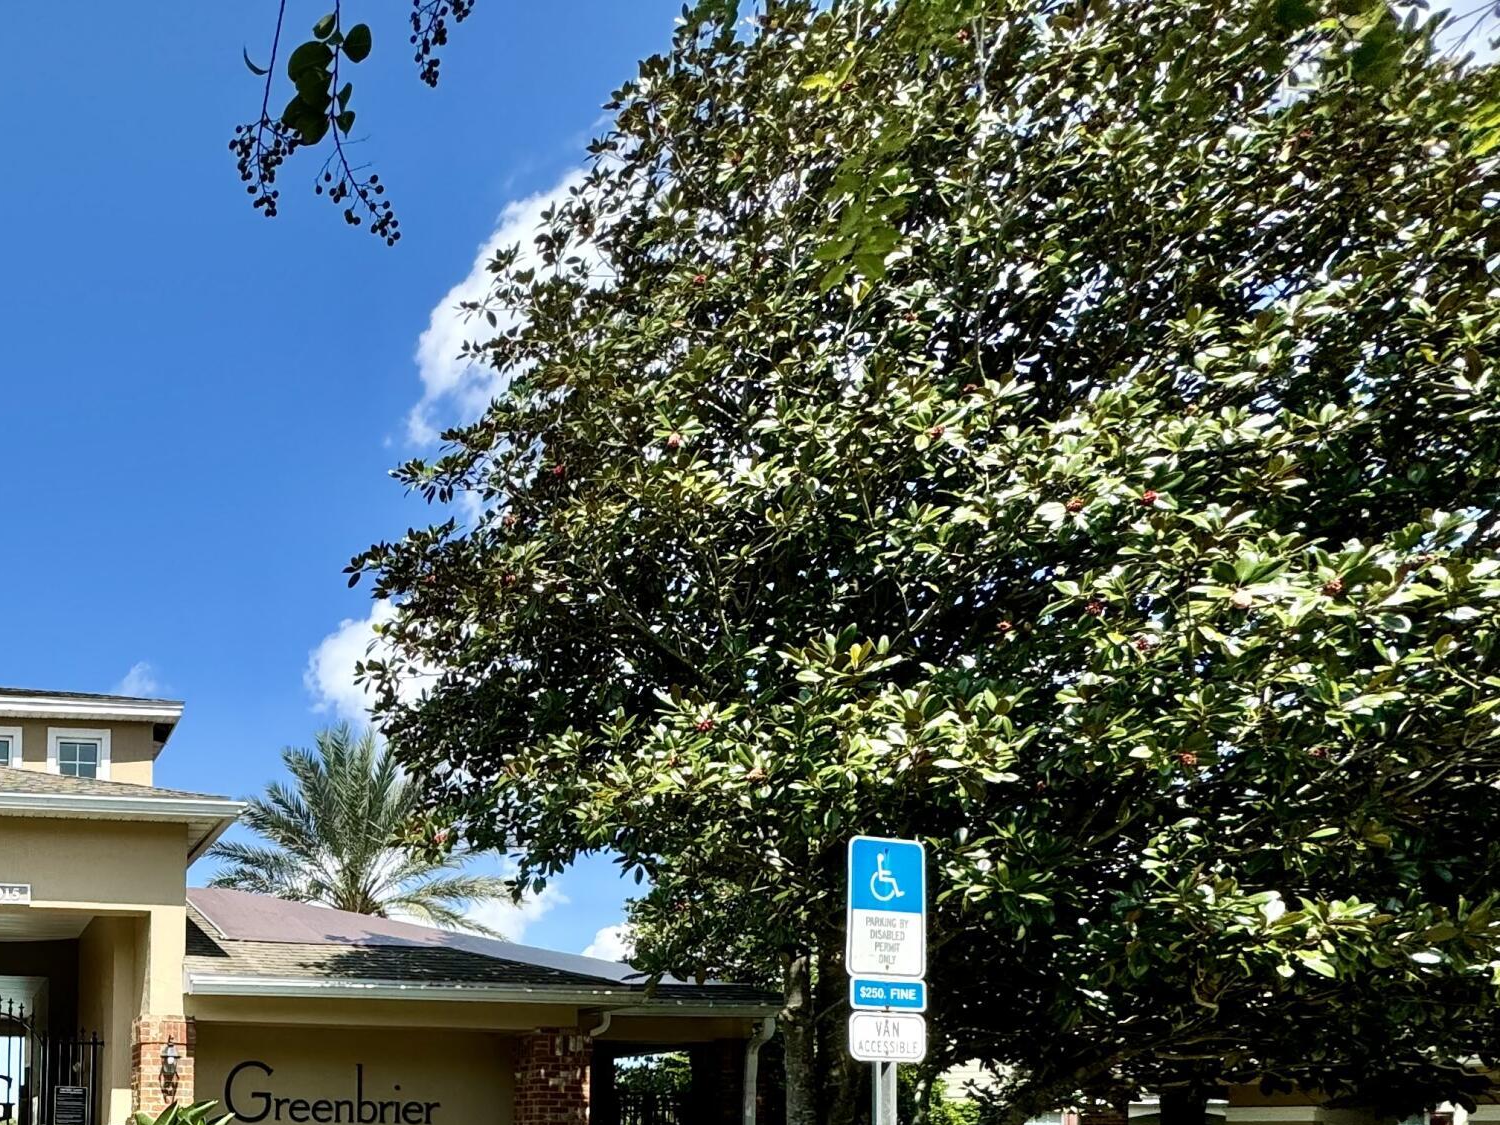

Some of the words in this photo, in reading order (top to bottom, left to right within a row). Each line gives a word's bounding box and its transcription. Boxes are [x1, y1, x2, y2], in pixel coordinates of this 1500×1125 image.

[865, 915, 897, 928] PARKING
[899, 917, 909, 929] BY
[869, 928, 905, 941] DISABLED
[874, 941, 900, 953] PERMIT
[878, 953, 896, 965] ONLY
[859, 985, 886, 1000] $250.
[890, 987, 917, 1001] FINE
[875, 1021, 900, 1038] VAN
[858, 1040, 918, 1054] ACCESSIBLE
[223, 1060, 441, 1125] Greenbrier
